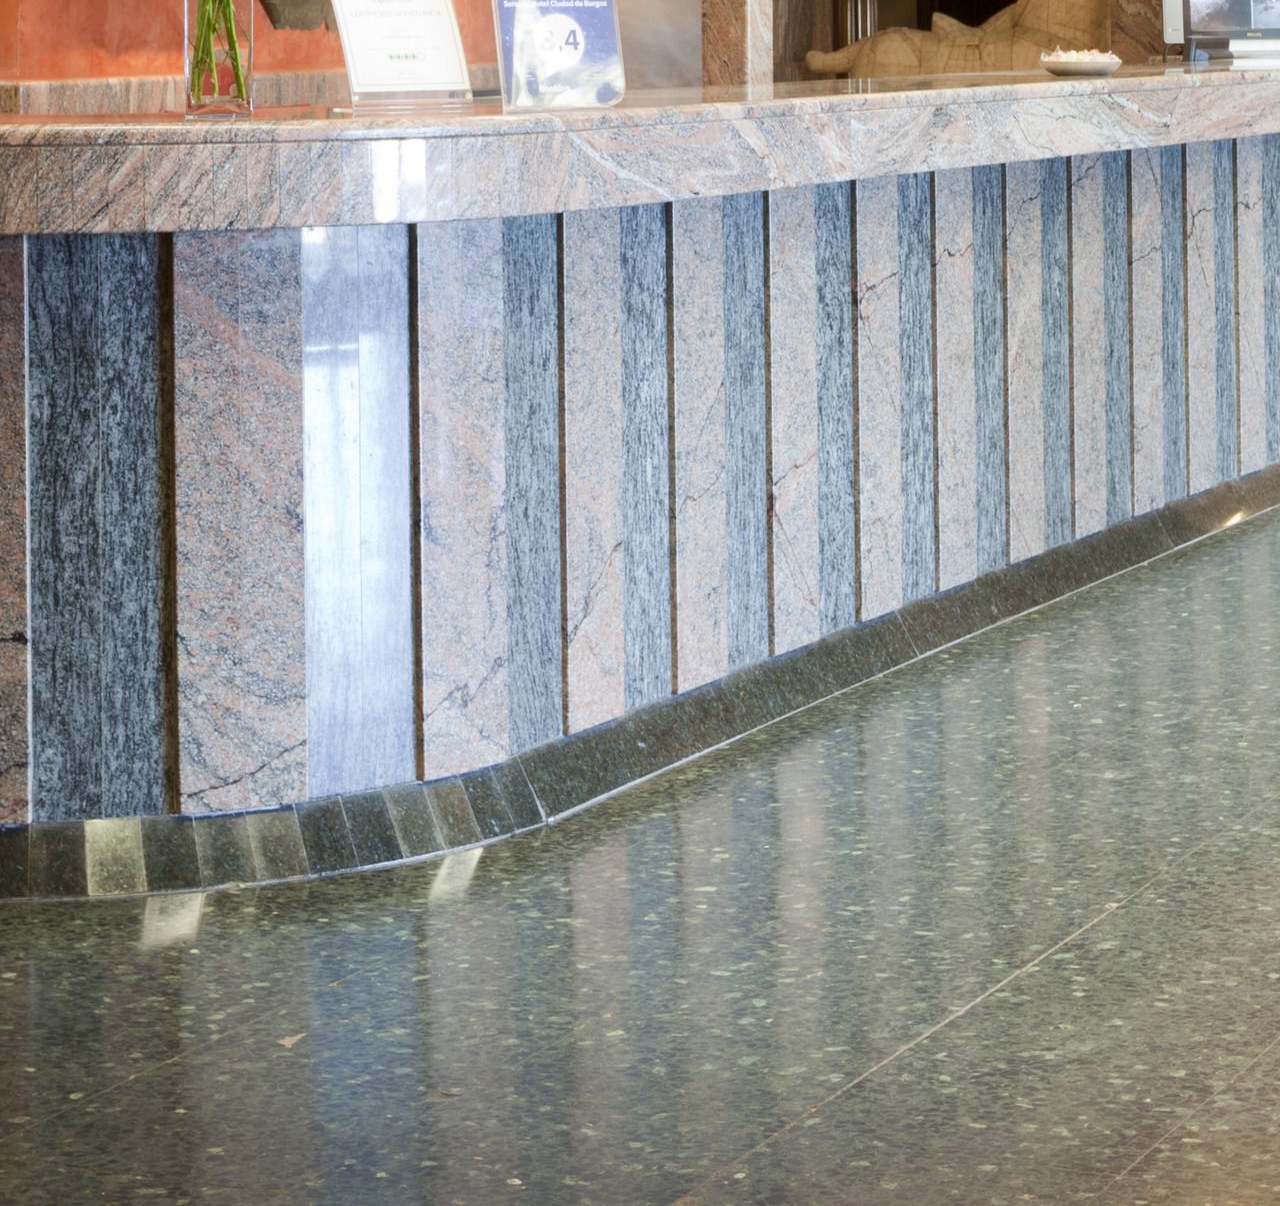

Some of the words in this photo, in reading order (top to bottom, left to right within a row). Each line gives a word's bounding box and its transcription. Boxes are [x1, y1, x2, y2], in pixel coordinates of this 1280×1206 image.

[550, 0, 574, 8] Ciudad
[574, 0, 583, 8] de
[583, 0, 608, 9] Burgos
